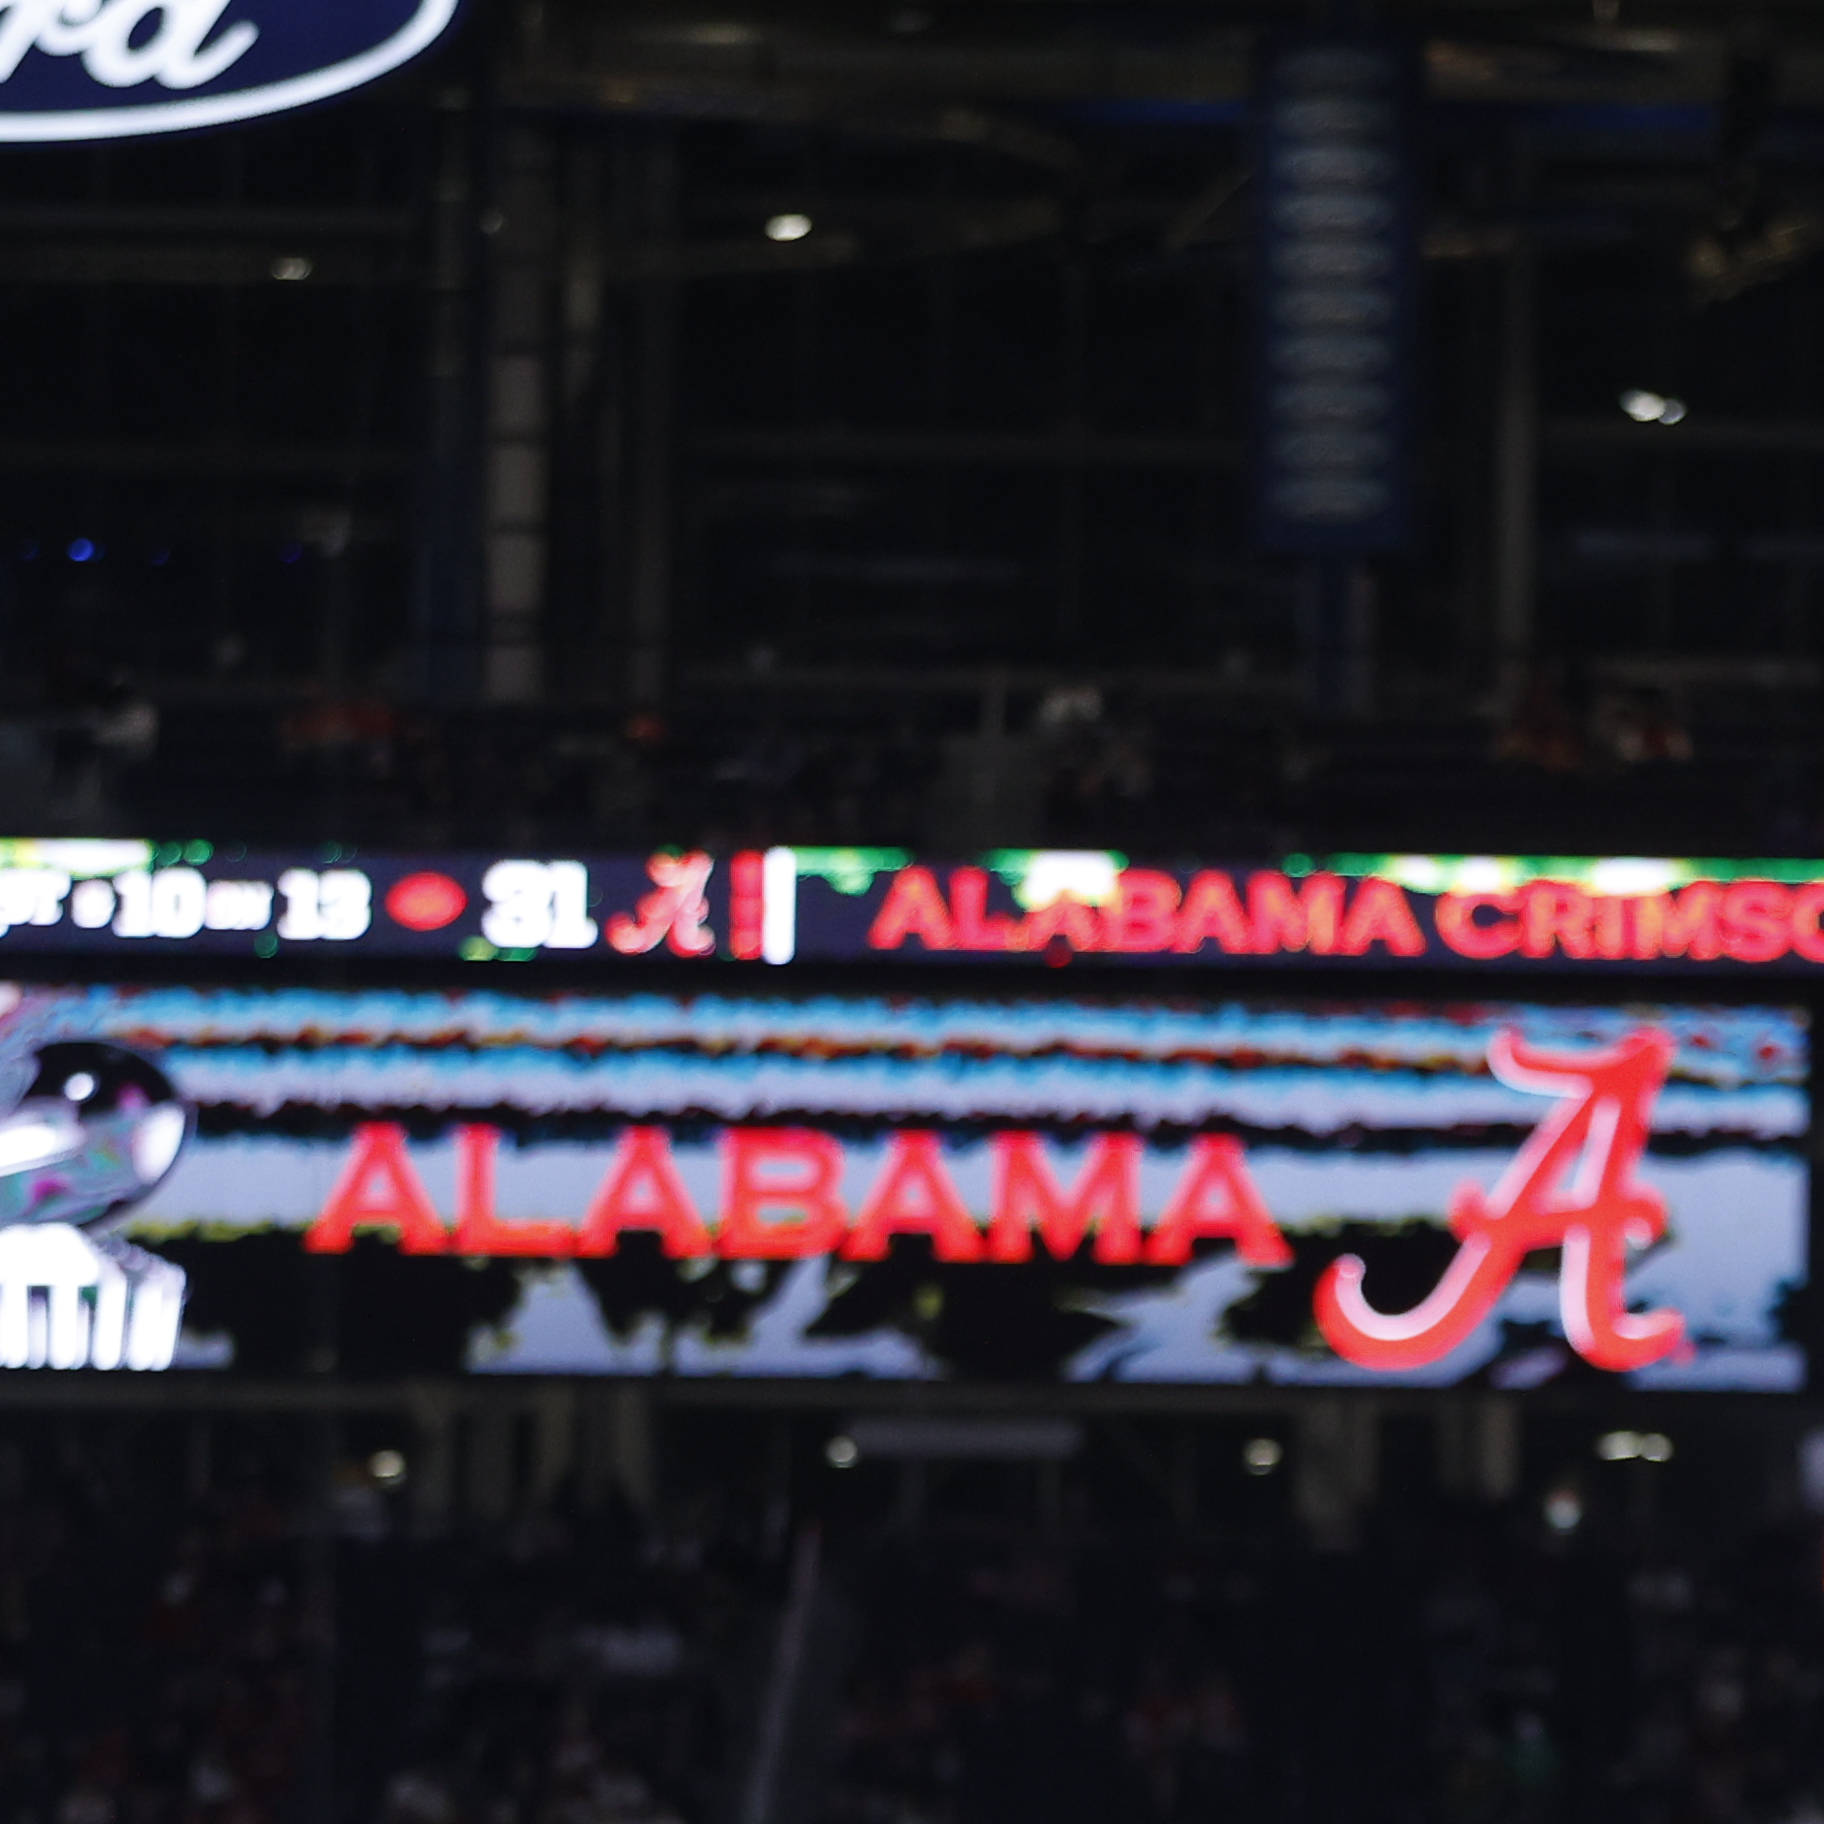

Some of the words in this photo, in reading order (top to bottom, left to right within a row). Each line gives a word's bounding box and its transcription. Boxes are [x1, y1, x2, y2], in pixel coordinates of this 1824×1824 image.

[481, 859, 599, 949] 31
[867, 863, 1428, 956] ALABAMA
[302, 1120, 1296, 1268] ALABAMA
